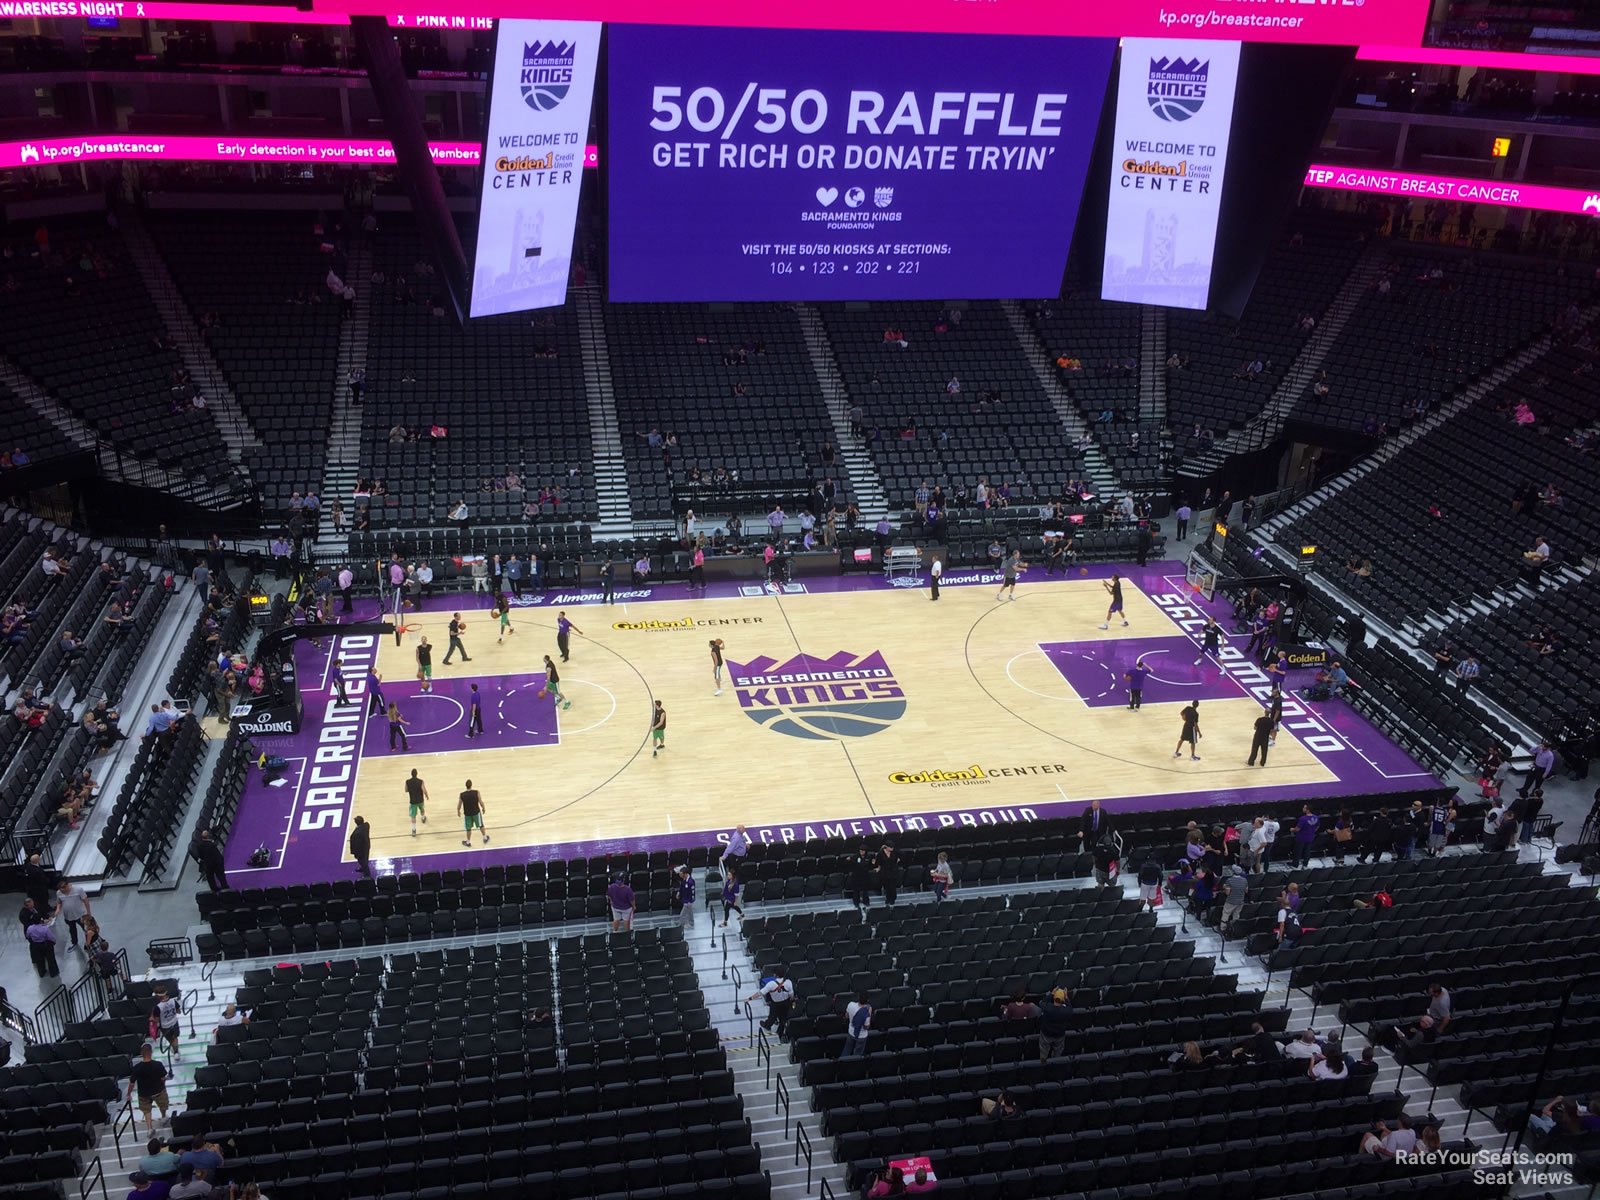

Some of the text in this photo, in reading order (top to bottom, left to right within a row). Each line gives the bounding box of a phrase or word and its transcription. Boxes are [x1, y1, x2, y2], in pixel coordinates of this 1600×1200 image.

[80, 3, 124, 16] NIGHT
[416, 15, 448, 26] PINK
[452, 16, 465, 27] IN
[1158, 9, 1304, 27] kp.org/breastcancer
[523, 58, 573, 66] SACRAMENTO
[520, 68, 573, 83] KINGS
[1150, 72, 1206, 82] SACRAMENTO
[1147, 82, 1207, 97] KINGS
[649, 83, 1068, 139] 50/50 RAFFLE
[499, 133, 579, 148] WELCOME TO
[42, 142, 165, 158] kp.org/breastcancer
[217, 143, 246, 156] Early
[249, 143, 304, 156] detection
[308, 143, 317, 156] is
[320, 146, 345, 159] your
[349, 145, 374, 157] best
[652, 142, 710, 168] GET
[718, 144, 788, 168] RICH
[797, 144, 836, 169] OR
[844, 145, 958, 170] DONATE
[1126, 140, 1216, 157] WELCOME TO
[555, 154, 574, 162] Credit
[1188, 164, 1212, 173] Credit
[493, 170, 573, 189] CENTER
[1120, 175, 1210, 194] CENTER
[1306, 168, 1522, 203] TEP AGAINST BREAST CANCER.
[801, 212, 903, 221] SACRAMENTO KINGS
[741, 244, 952, 255] VISIT THE 50/50 KIOSKS AT SECTIONS:
[770, 262, 920, 274] 104 123 202 221
[697, 617, 764, 627] CENTER
[736, 668, 888, 686] SACRAMENTO
[735, 680, 905, 708] KINGS
[239, 720, 294, 735] SPALDING
[988, 764, 1068, 778] CENTER
[1434, 813, 1444, 823] 15
[163, 1008, 176, 1019] 23
